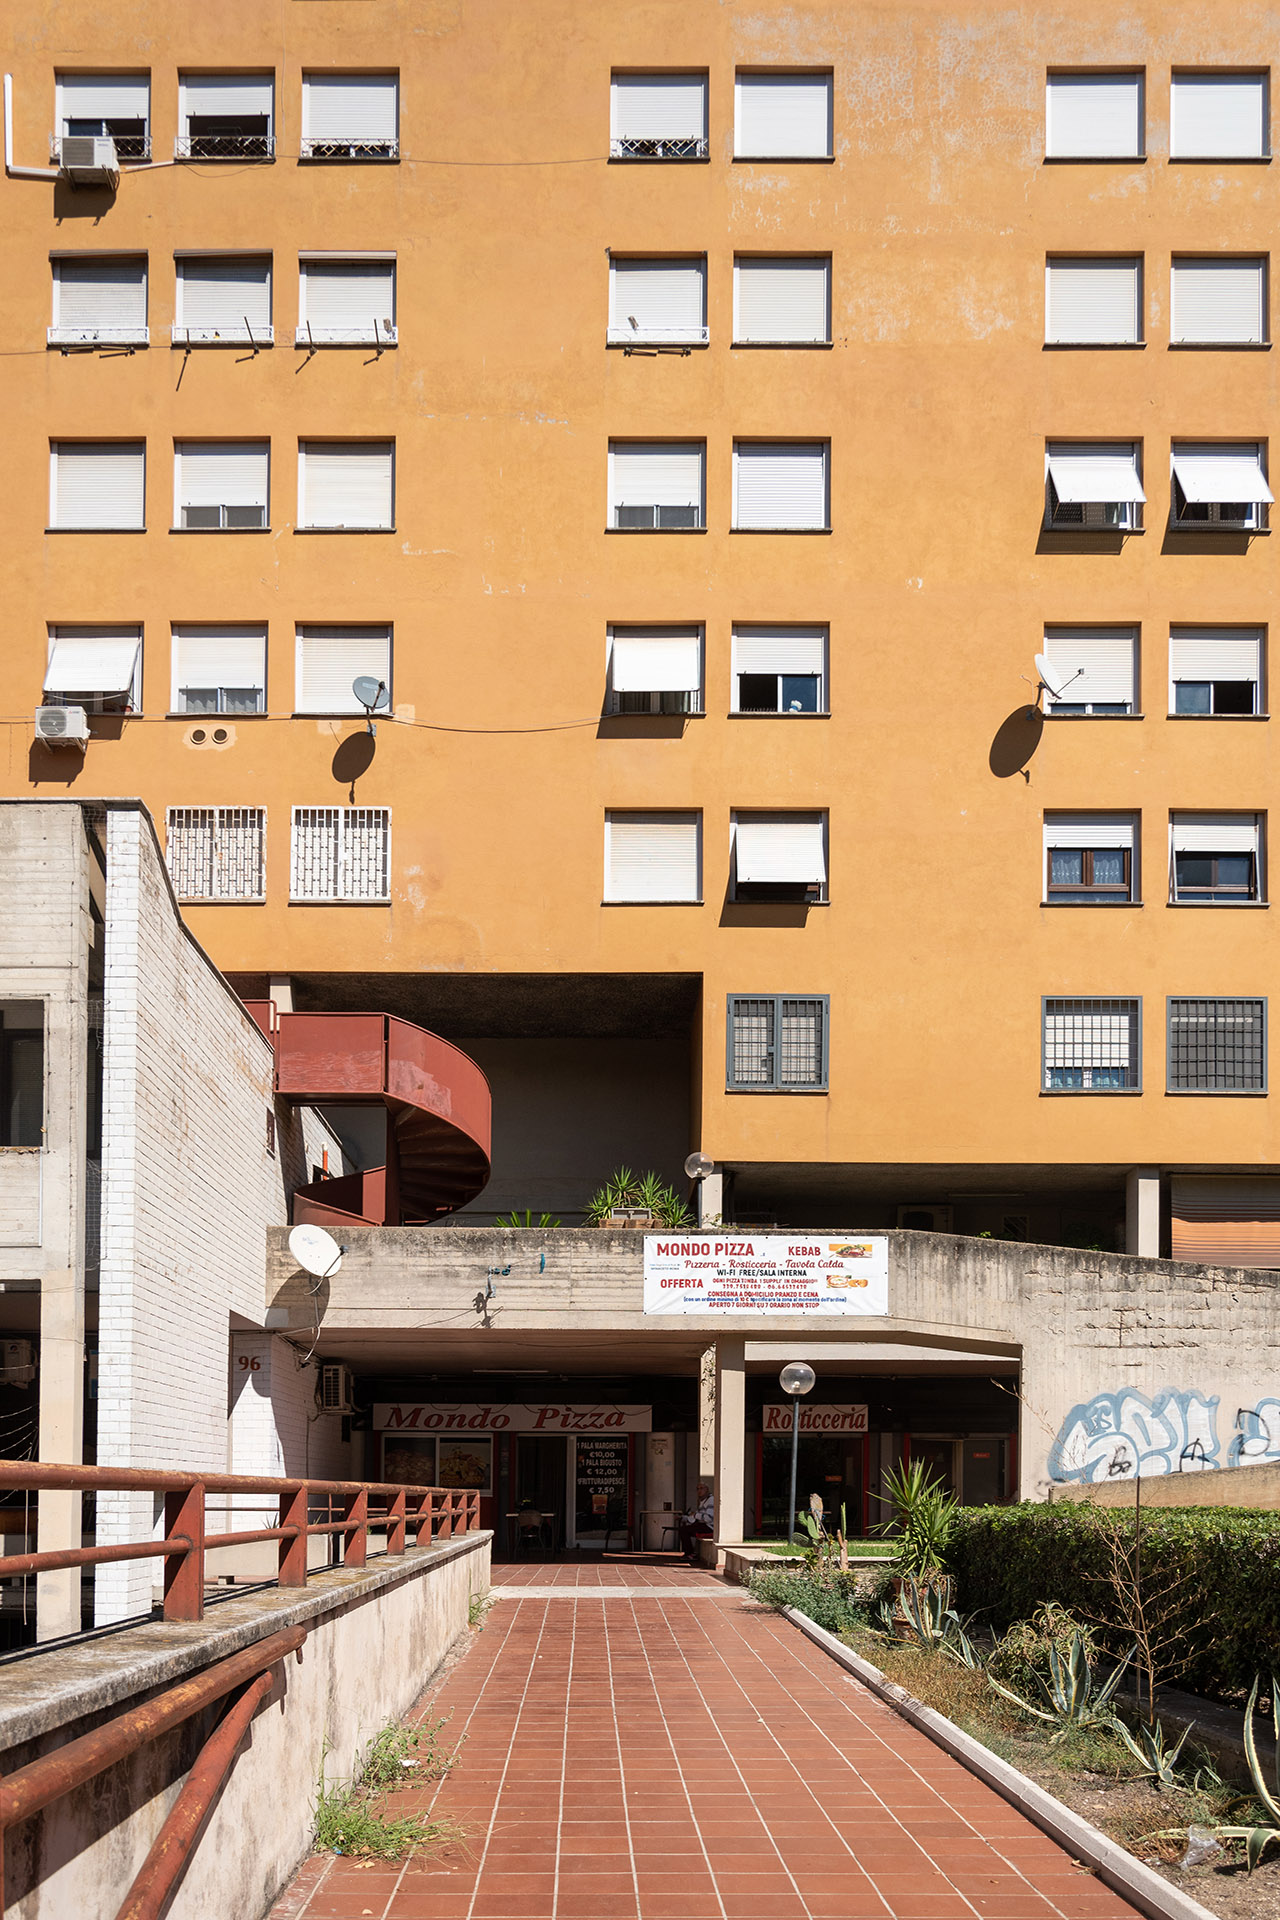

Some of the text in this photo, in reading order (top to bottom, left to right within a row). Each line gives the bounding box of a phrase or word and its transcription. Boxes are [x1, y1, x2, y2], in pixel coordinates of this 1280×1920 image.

[657, 1243, 754, 1256] MONDO PIZZA
[788, 1246, 821, 1256] KEBAB
[684, 1260, 719, 1268] Pizzeria
[728, 1259, 776, 1268] Rosticceria
[785, 1259, 815, 1268] Tavola
[818, 1259, 844, 1268] Calda
[660, 1279, 703, 1288] OFFERTA
[239, 1356, 261, 1370] 96
[384, 1407, 626, 1429] Mondo Pizza
[766, 1407, 866, 1429] Roticceria
